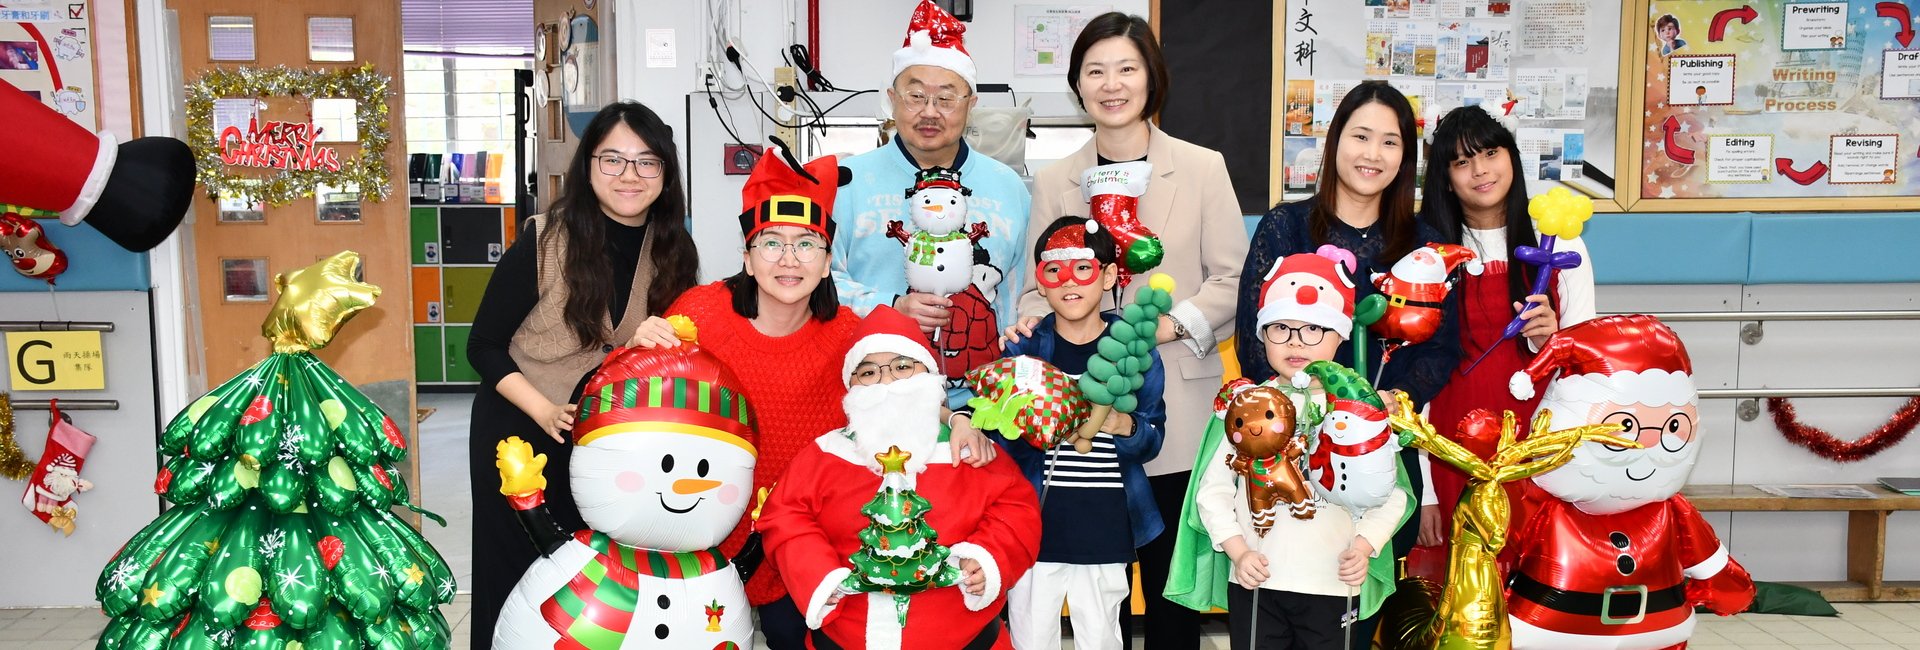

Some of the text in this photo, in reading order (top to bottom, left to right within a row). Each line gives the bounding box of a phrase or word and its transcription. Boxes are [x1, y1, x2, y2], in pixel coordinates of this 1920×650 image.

[1792, 5, 1840, 15] Prewriting
[1293, 0, 1317, 76] 文科
[1680, 59, 1723, 69] Publishing
[1772, 67, 1836, 83] Writing
[1765, 98, 1837, 111] Process
[247, 117, 324, 148] MERRY
[219, 125, 340, 172] CHRISTMAS
[1725, 138, 1755, 148] Editing
[1845, 138, 1883, 148] Revising
[16, 339, 56, 385] G
